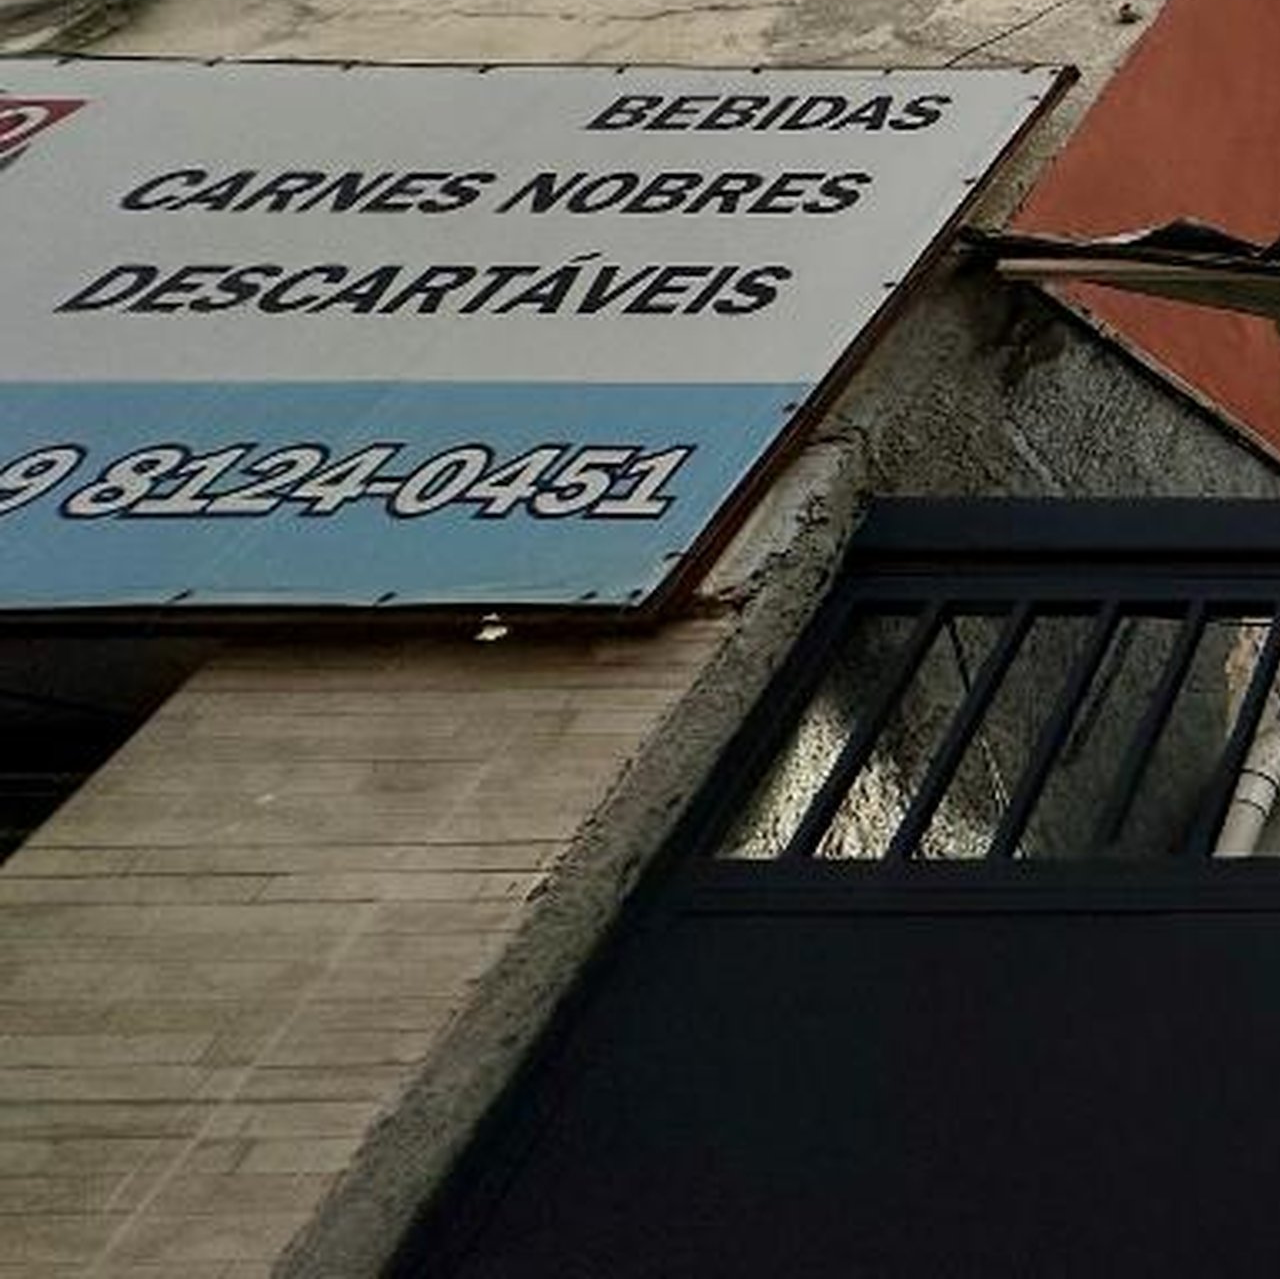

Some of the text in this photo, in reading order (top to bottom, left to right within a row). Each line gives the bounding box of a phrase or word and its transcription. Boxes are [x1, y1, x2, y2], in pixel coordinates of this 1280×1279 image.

[584, 93, 953, 132] BEBIDAS
[118, 168, 873, 215] CARNES NOBRES
[52, 251, 793, 317] DESCARTÁVEIS
[60, 442, 697, 520] 8124-0451
